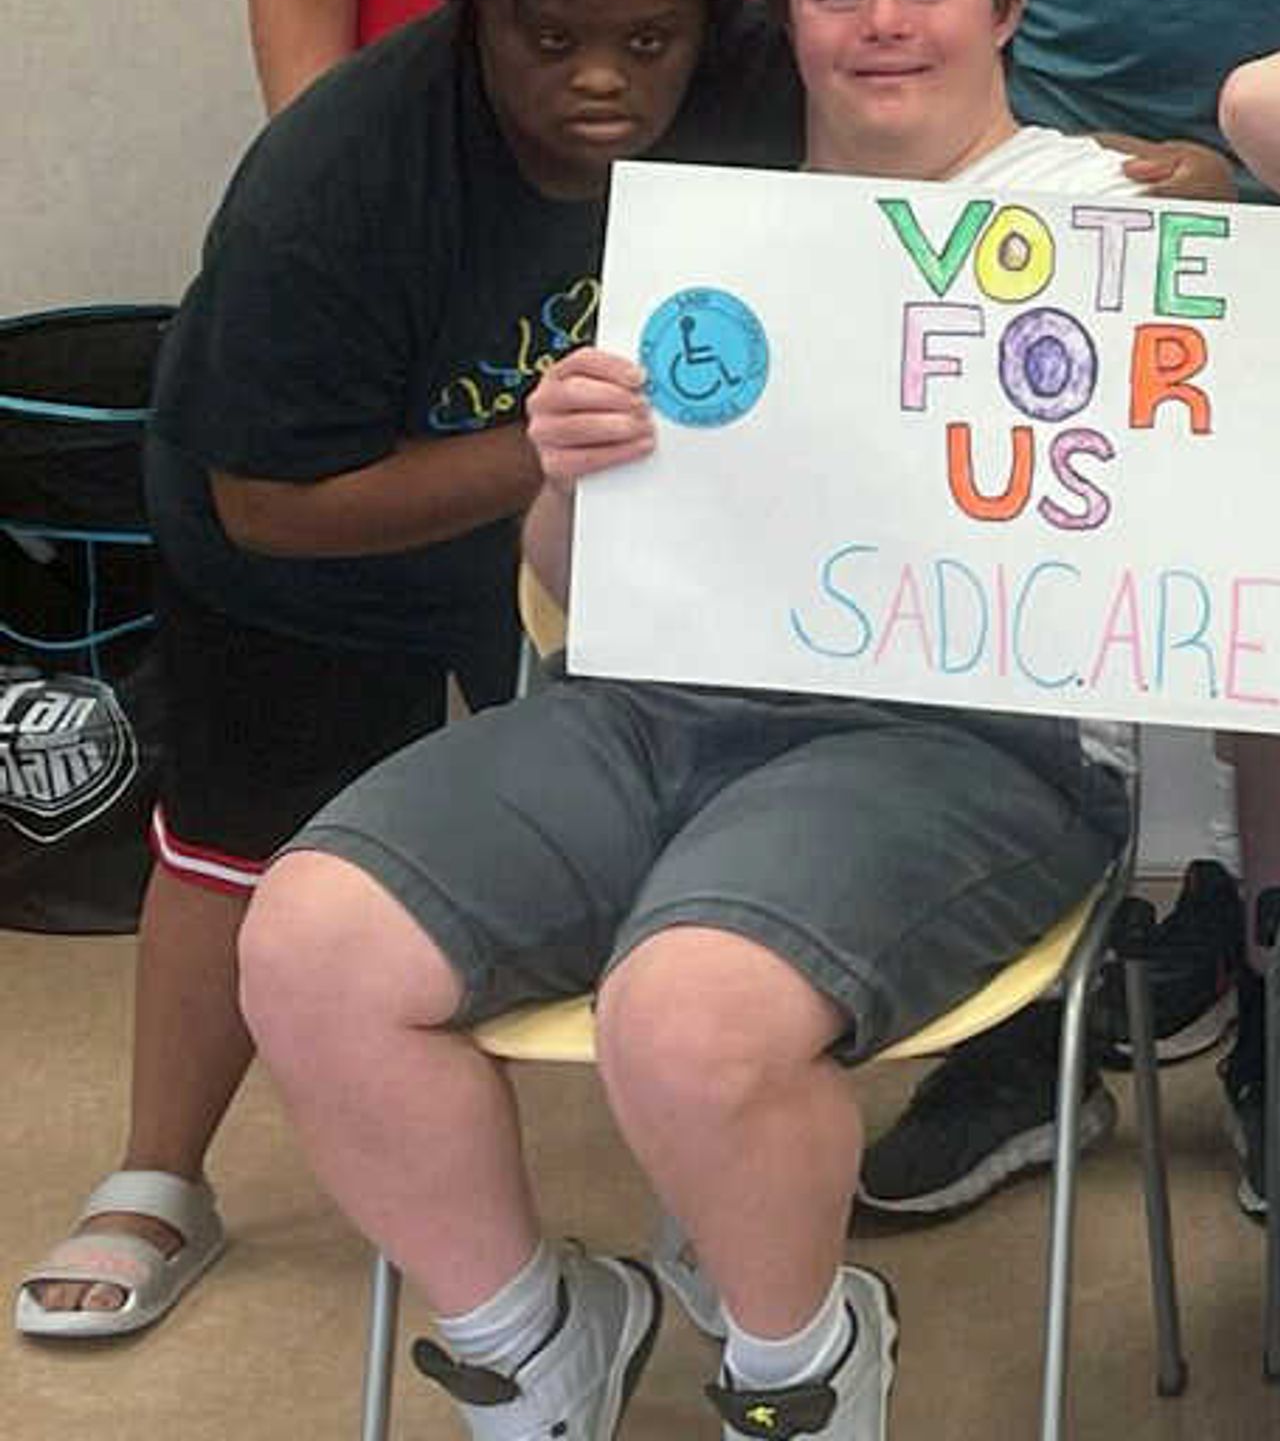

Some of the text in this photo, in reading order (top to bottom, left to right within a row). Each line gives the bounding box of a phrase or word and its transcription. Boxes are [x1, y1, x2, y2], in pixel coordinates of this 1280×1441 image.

[875, 198, 1231, 319] VOTE
[900, 301, 1213, 435] FOR
[946, 421, 1116, 531] US
